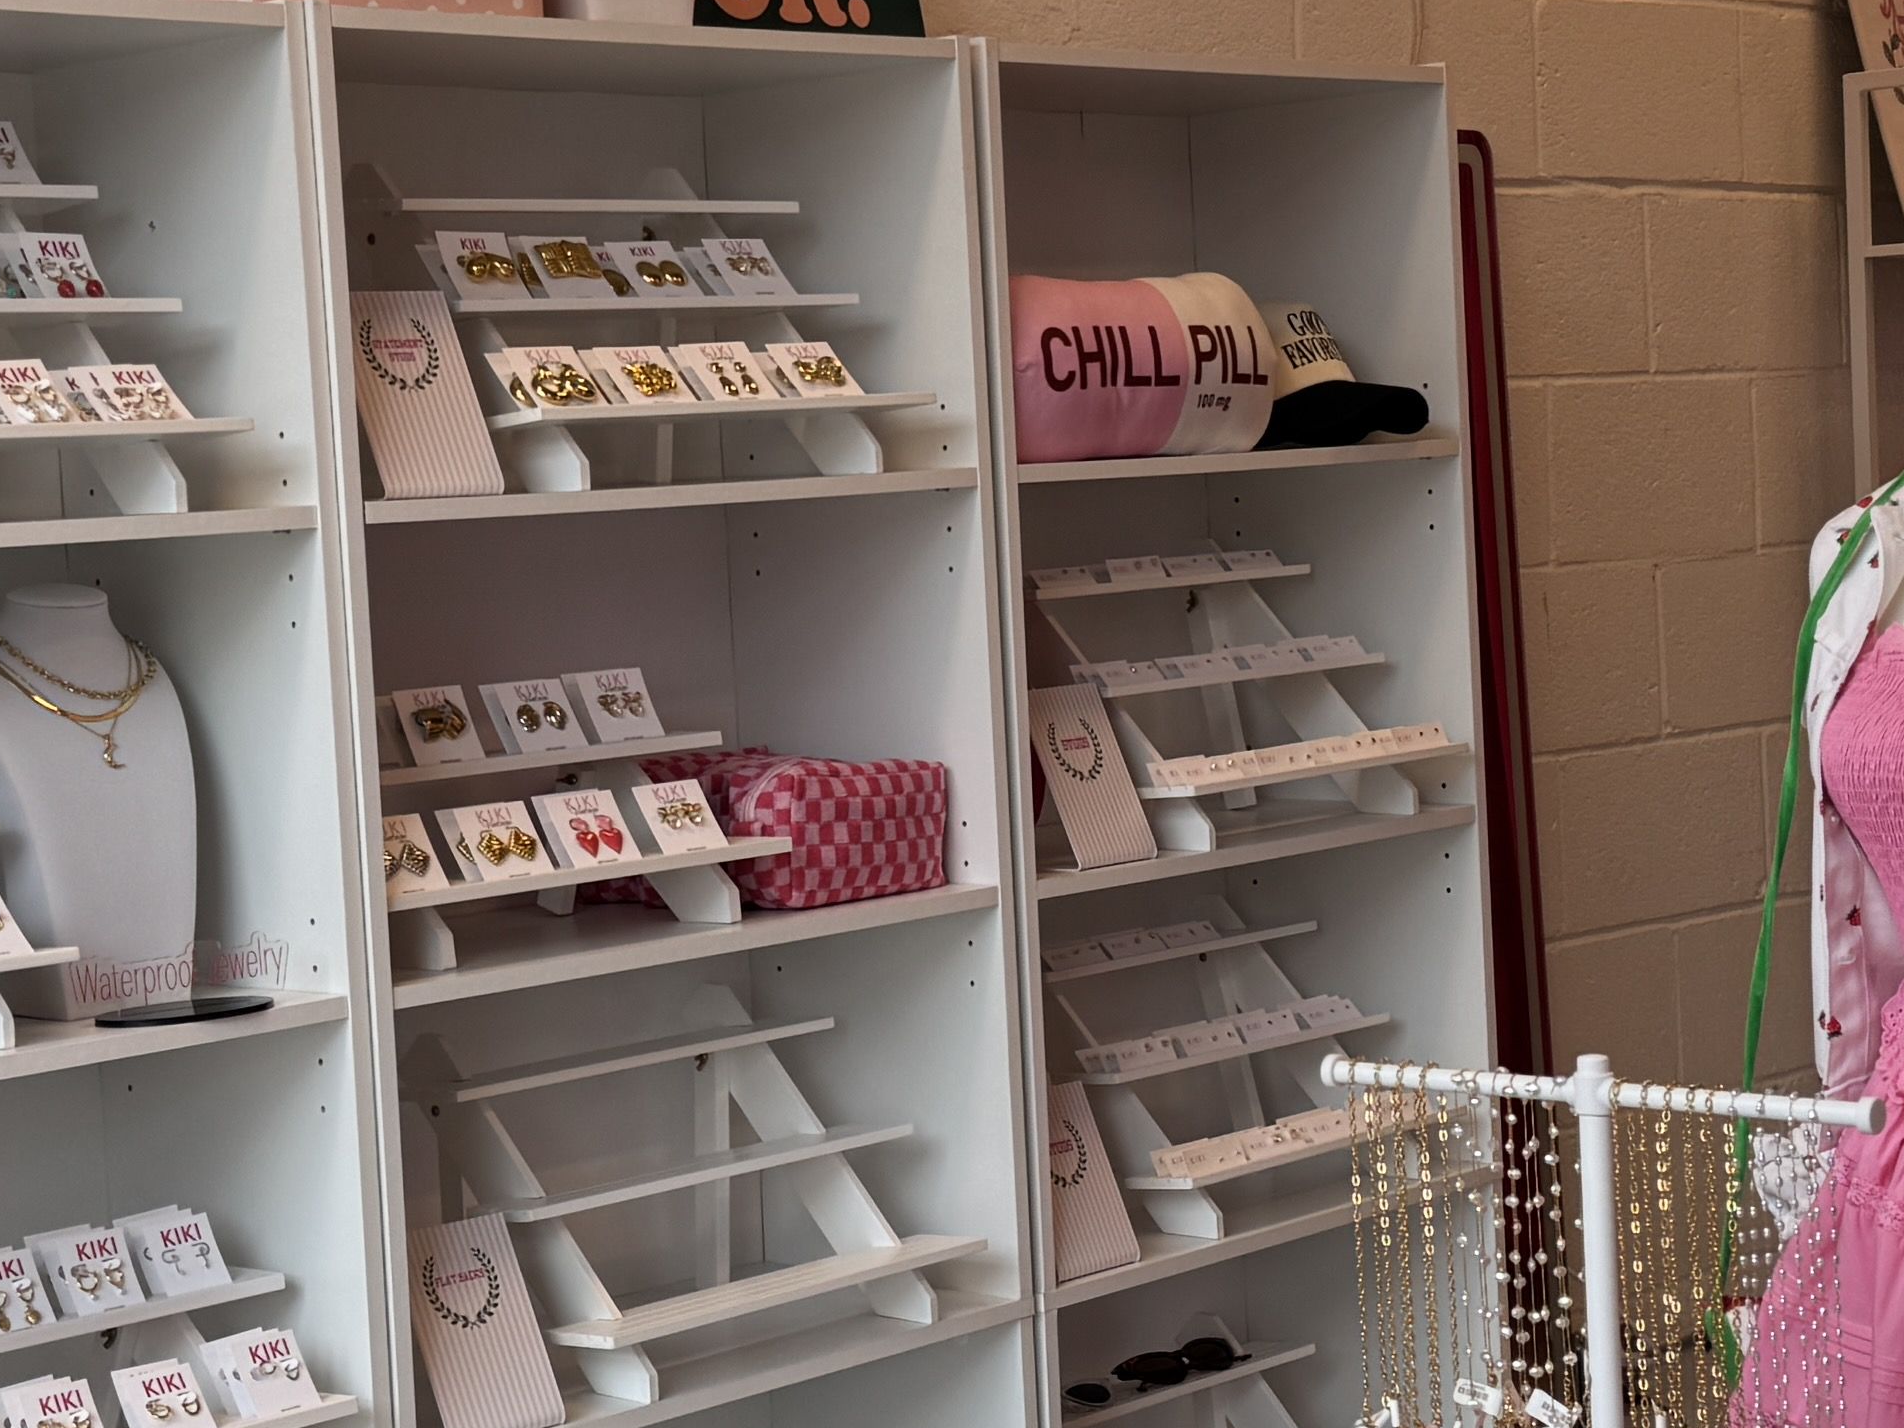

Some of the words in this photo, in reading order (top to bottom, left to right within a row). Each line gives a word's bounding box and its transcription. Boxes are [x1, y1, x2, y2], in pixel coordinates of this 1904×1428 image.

[461, 238, 486, 250] KIKI
[1040, 325, 1180, 392] CHILL
[1188, 325, 1268, 385] PILL
[112, 371, 155, 386] KIKI
[74, 957, 195, 1006] Waterproo
[160, 1223, 202, 1248] KIKI
[142, 1373, 186, 1398] KIKI
